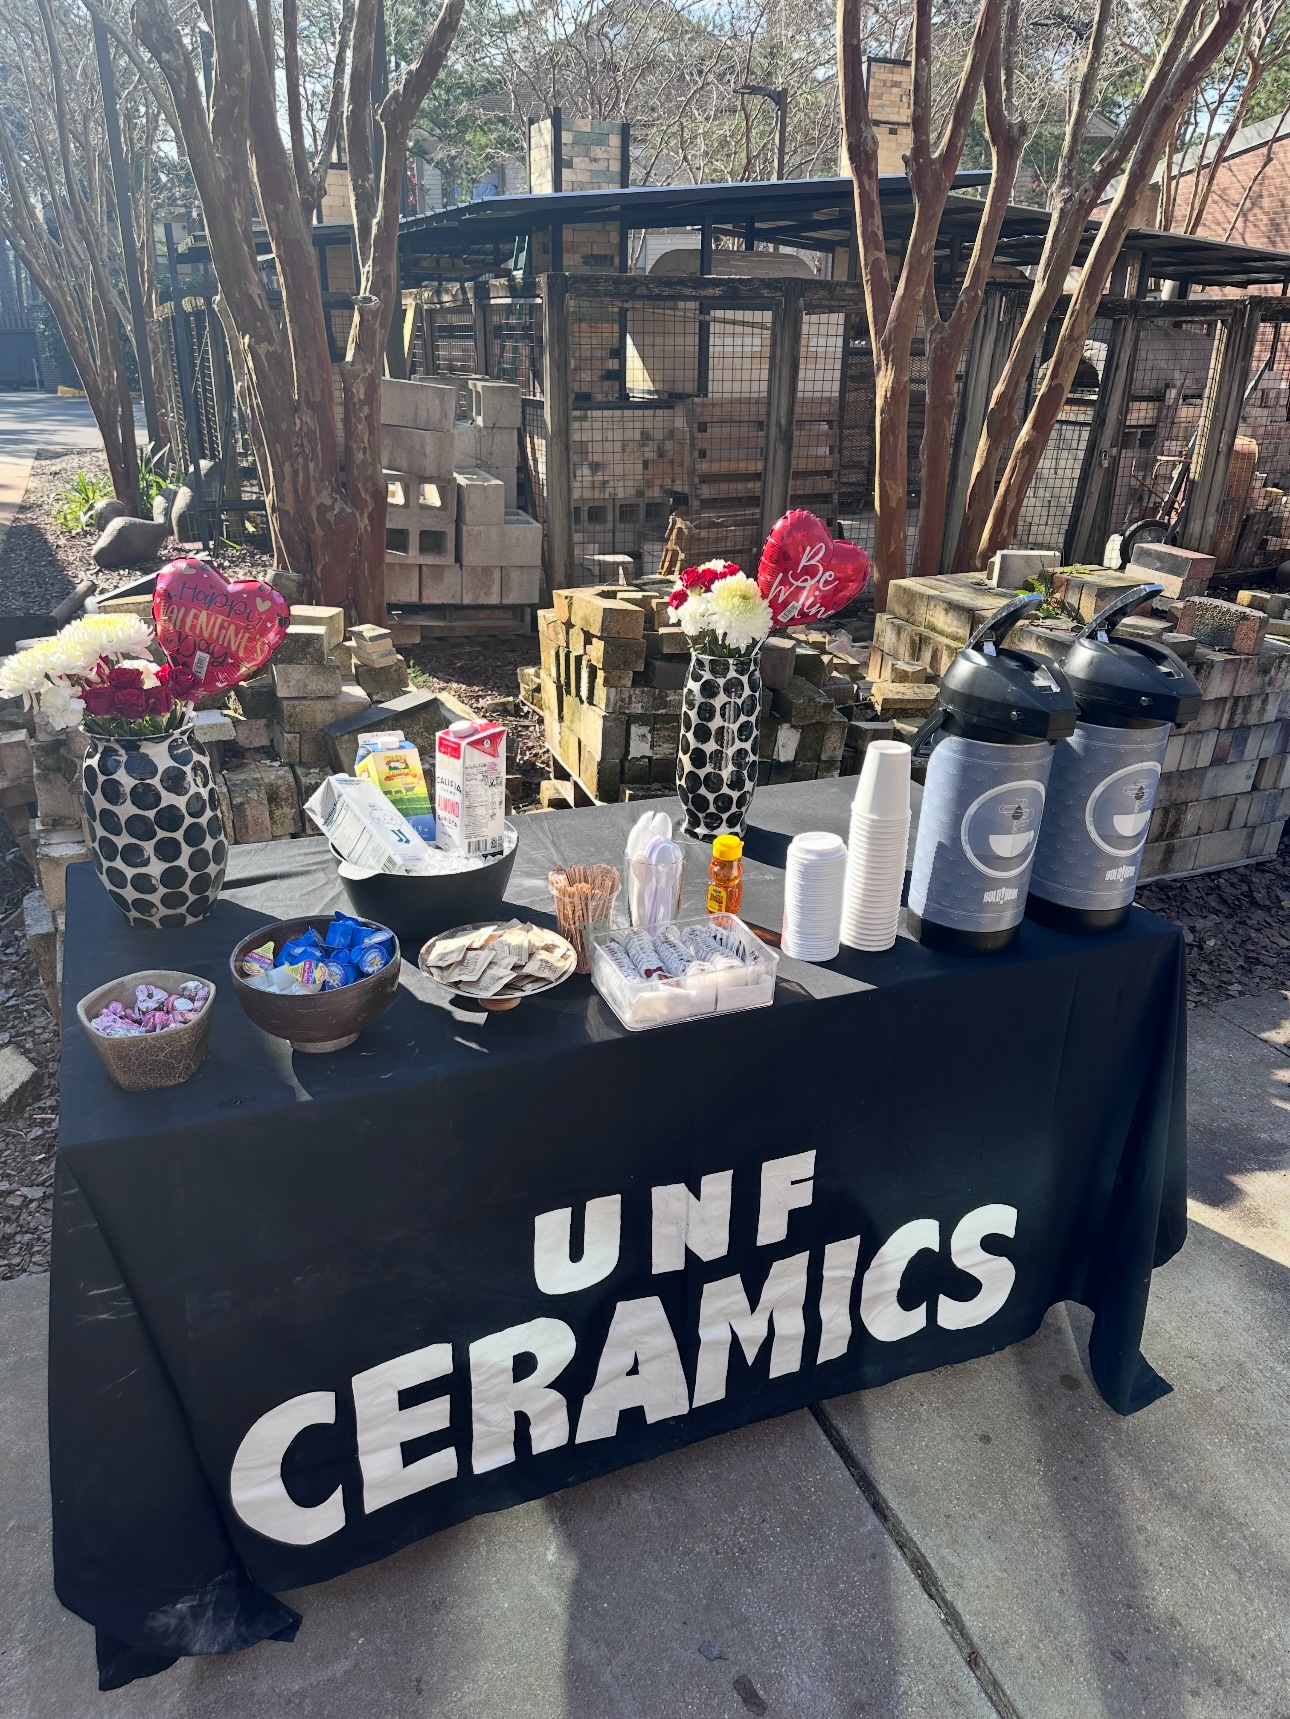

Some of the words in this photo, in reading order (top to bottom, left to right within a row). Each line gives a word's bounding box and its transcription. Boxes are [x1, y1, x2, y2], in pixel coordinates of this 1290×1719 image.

[788, 542, 840, 591] Be
[179, 581, 263, 631] Happy
[177, 631, 228, 666] Day
[436, 776, 462, 794] CALIFIA
[437, 794, 460, 818] ALMOND
[533, 1149, 817, 1296] UNF
[230, 1203, 1018, 1546] CERAMICS
